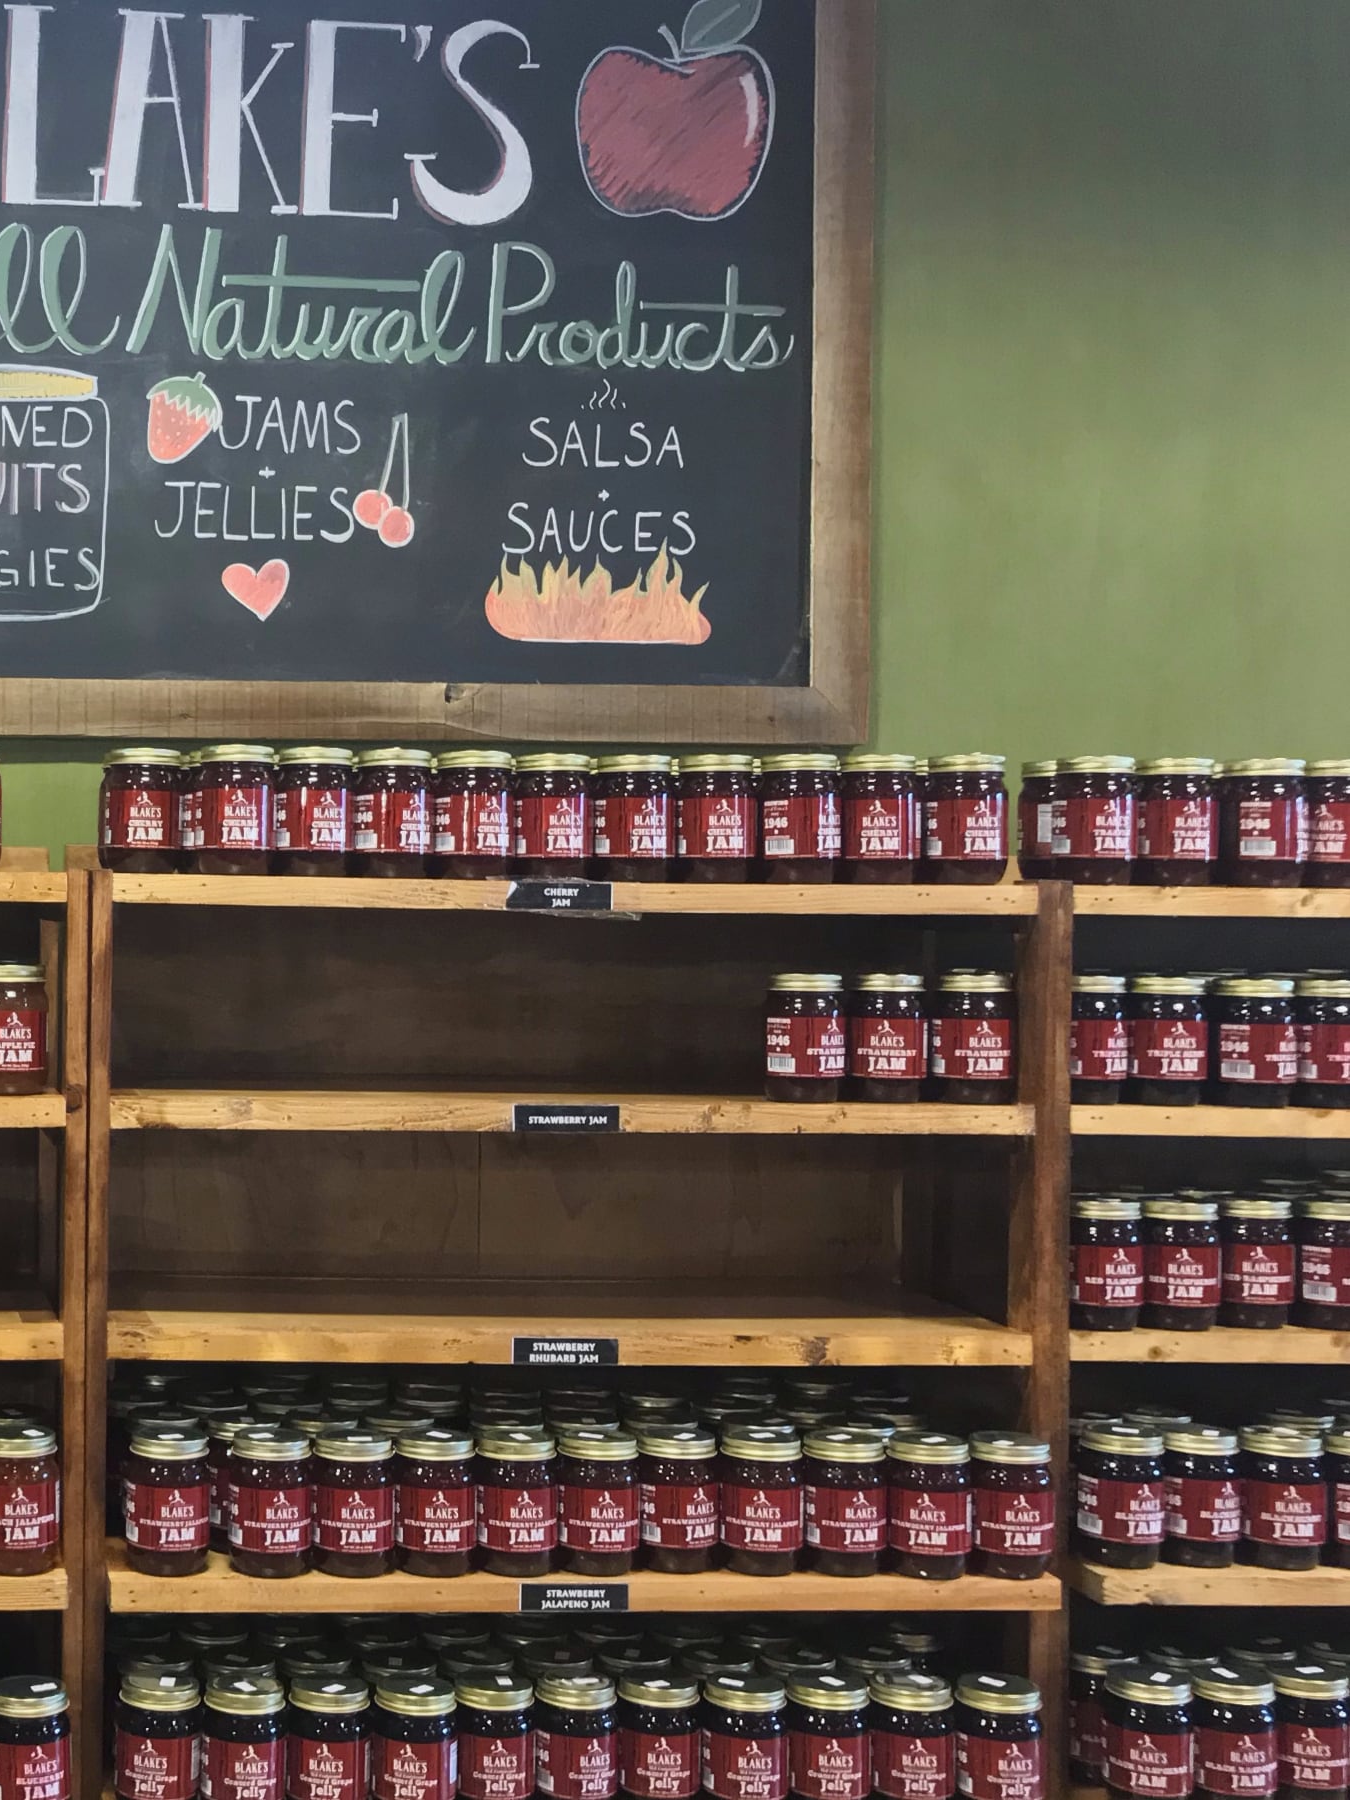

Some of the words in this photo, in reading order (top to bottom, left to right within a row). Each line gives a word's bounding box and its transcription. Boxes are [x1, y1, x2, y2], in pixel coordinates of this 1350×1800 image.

[125, 224, 476, 366] Natural
[485, 242, 795, 370] Products
[219, 397, 361, 455] JAMS
[522, 418, 685, 470] SALSA
[153, 481, 355, 543] JELLIES
[501, 503, 697, 556] SAUCES
[130, 807, 161, 817] BLAKE'S
[225, 806, 256, 817] BLAKE'S
[128, 820, 163, 828] CHERRY
[550, 814, 580, 825] BLAKE'S
[765, 817, 788, 828] 1946
[863, 816, 896, 827] BLAKE'S
[967, 816, 1000, 827] BLAKE'S
[1176, 817, 1209, 827] BLAKE'S
[127, 828, 163, 844] JAM
[222, 827, 259, 842] JAM
[547, 835, 583, 850] JAM
[860, 837, 901, 854] JAM
[964, 838, 1000, 852] JAM
[1174, 838, 1209, 852] JAM
[544, 888, 578, 896] CHERRY
[552, 899, 570, 907] JAM
[0, 1029, 31, 1039] BLAKE'S
[768, 1035, 789, 1045] 1946
[870, 1036, 904, 1047] BLAKE'S
[1164, 1038, 1196, 1048] BLAKE'S
[868, 1057, 906, 1071] JAM
[1160, 1058, 1199, 1074] JAM
[589, 1116, 607, 1125] JAM
[1243, 1262, 1277, 1272] BLAKE'S
[1242, 1283, 1278, 1296] JAM
[533, 1343, 595, 1351] STRAWBERRY
[530, 1354, 575, 1362] RHUBARB
[579, 1355, 598, 1364] JAM
[342, 1508, 374, 1519] BLAKE'S
[1276, 1502, 1311, 1513] BLAKE'S
[910, 1510, 945, 1522] BLAKE'S
[339, 1529, 377, 1543] JAM
[1273, 1523, 1314, 1538] JAM
[909, 1531, 947, 1545] JAM
[542, 1600, 588, 1609] JALAPENO
[592, 1601, 609, 1609] JAM
[134, 1755, 167, 1769] BLAKE'S
[819, 1755, 853, 1767] BLAKE'S
[1130, 1749, 1167, 1764] BLAKE'S
[310, 1760, 343, 1772] BLAKE'S
[135, 1780, 165, 1793] Jelly
[1130, 1773, 1167, 1788] JAM
[310, 1784, 343, 1800] Jelly
[820, 1778, 851, 1796] Jelly
